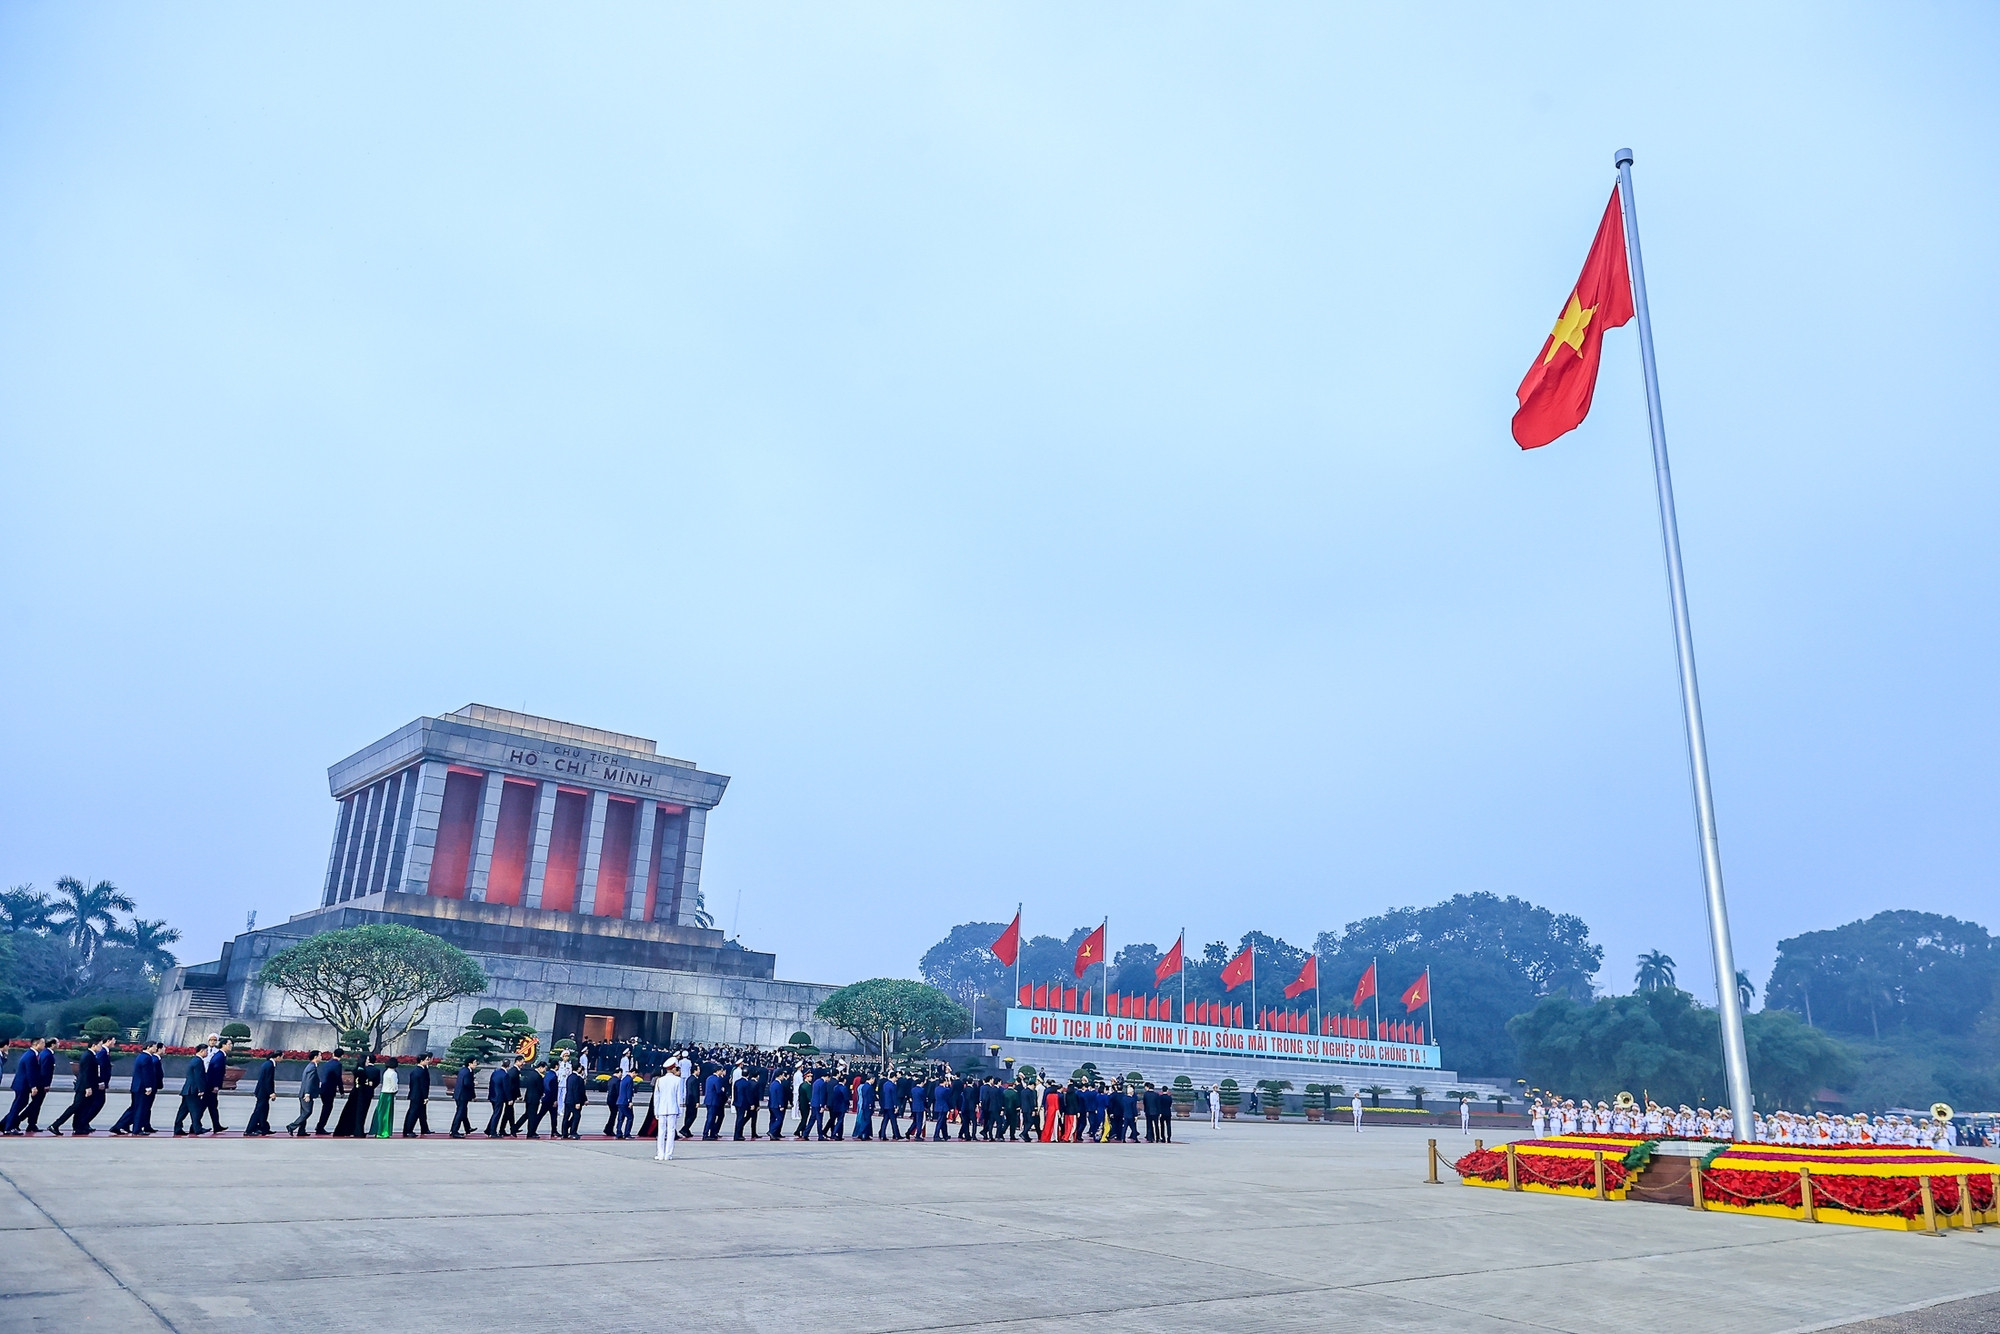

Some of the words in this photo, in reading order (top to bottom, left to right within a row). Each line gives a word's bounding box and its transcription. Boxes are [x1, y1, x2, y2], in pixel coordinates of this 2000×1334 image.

[1031, 1013, 1057, 1035] CHỦ
[1063, 1018, 1091, 1040] TỊCH
[1096, 1017, 1112, 1039] HỒ
[1117, 1021, 1138, 1041] CHÍ
[1142, 1025, 1173, 1044] MINH
[1177, 1026, 1188, 1045] VĨ
[1192, 1030, 1211, 1050] ĐẠI
[1215, 1028, 1244, 1050] SỐNG
[1248, 1033, 1267, 1051] MÃI
[1271, 1037, 1303, 1054] TRONG
[1307, 1039, 1320, 1058] SỰ
[1322, 1040, 1356, 1060] NGHIỆP
[1358, 1041, 1376, 1059] CỦA
[1379, 1044, 1407, 1062] CHÚNG
